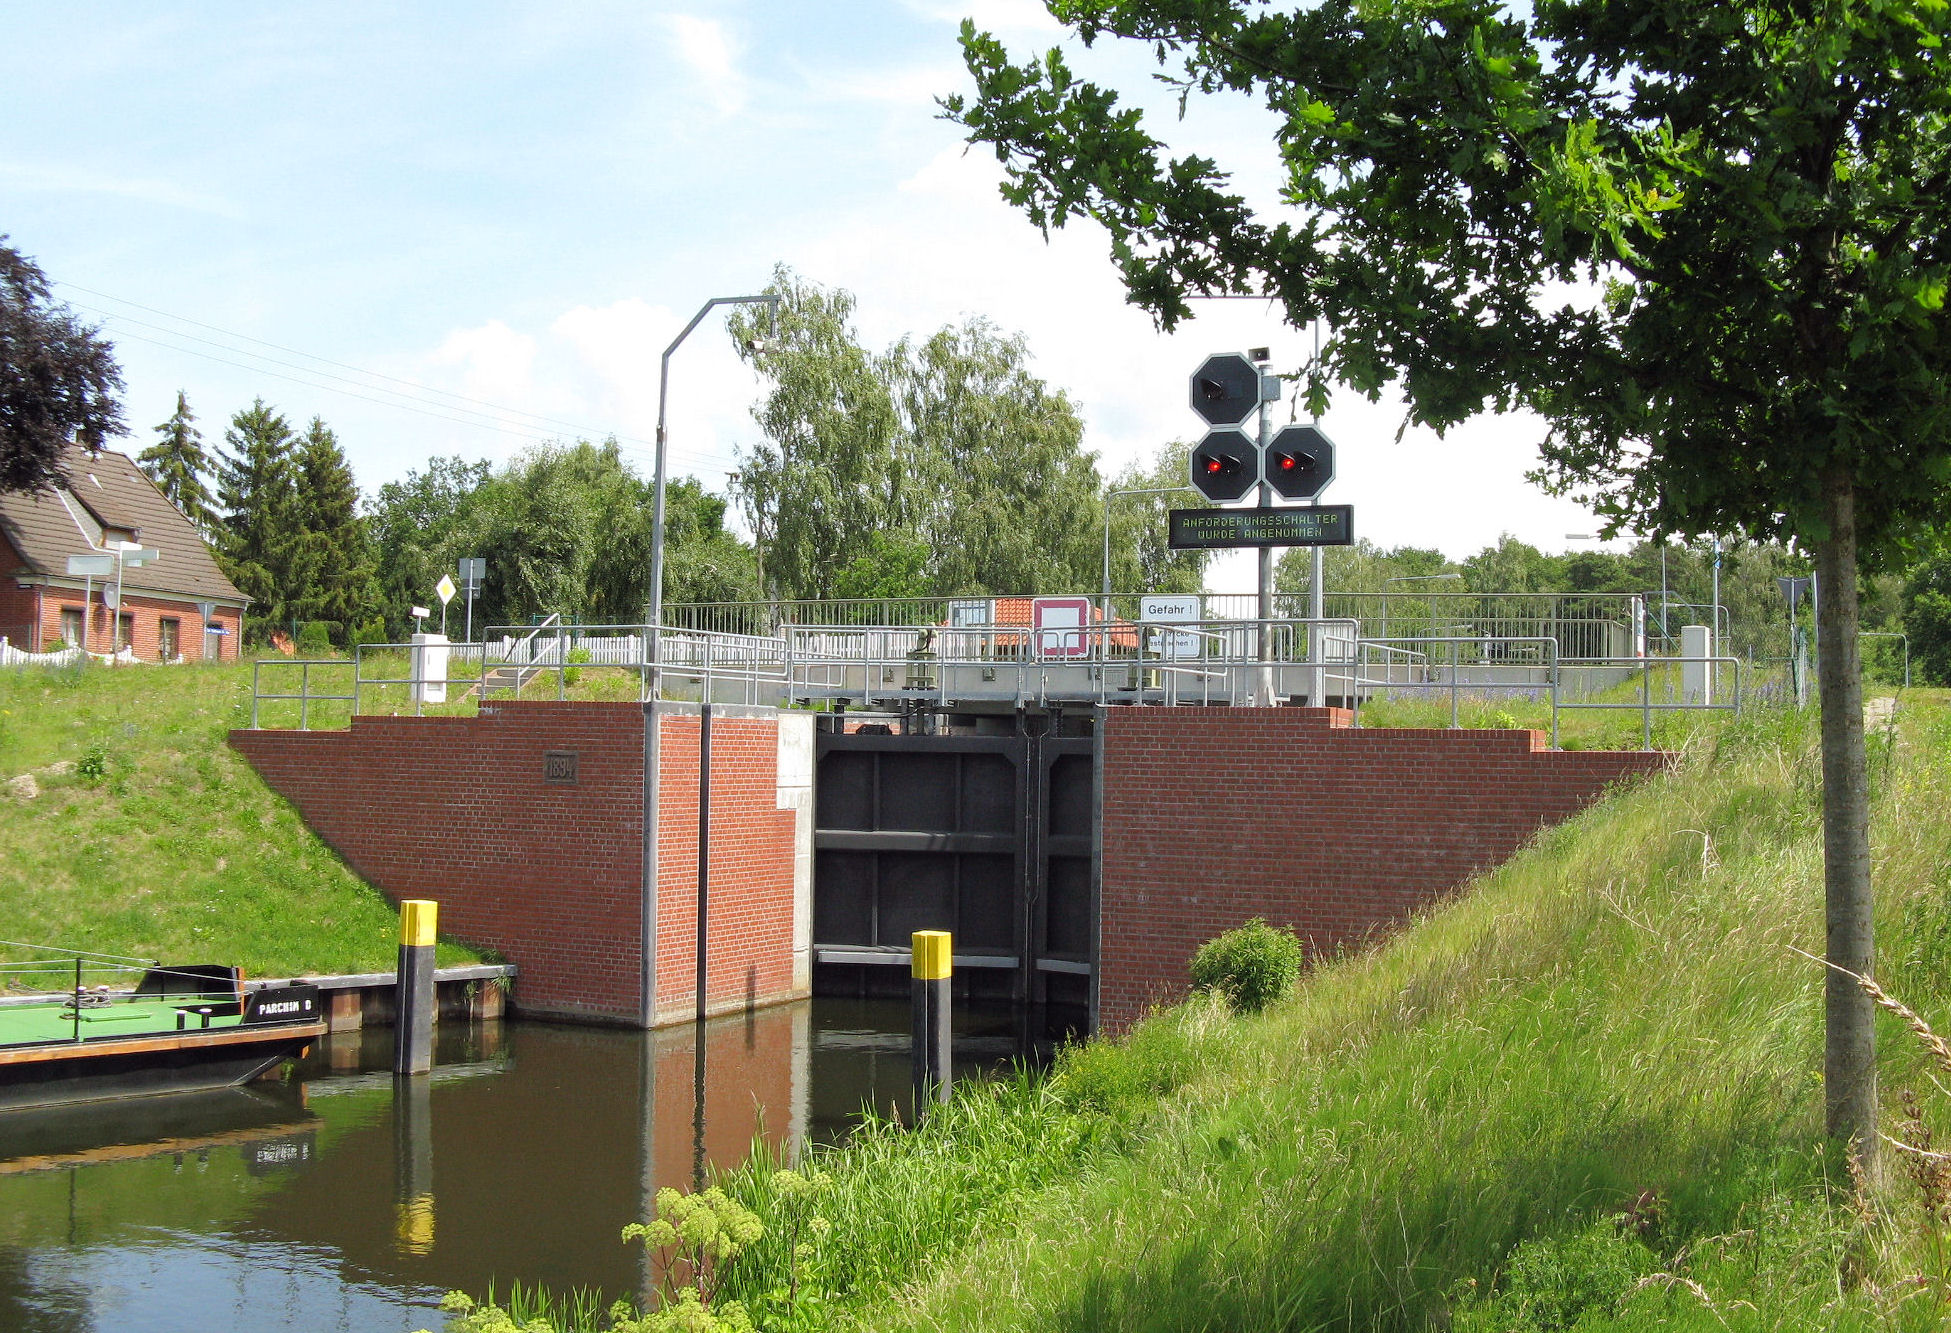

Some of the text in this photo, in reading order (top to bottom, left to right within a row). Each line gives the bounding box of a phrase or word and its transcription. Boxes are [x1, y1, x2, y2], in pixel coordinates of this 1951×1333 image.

[1183, 515, 1338, 528] ANFORDERUNGSSCHALTER
[1197, 527, 1322, 540] WURDE ANGENOMMEN
[1148, 604, 1193, 615] Gefahr !
[259, 1000, 300, 1015] PARCHIM
